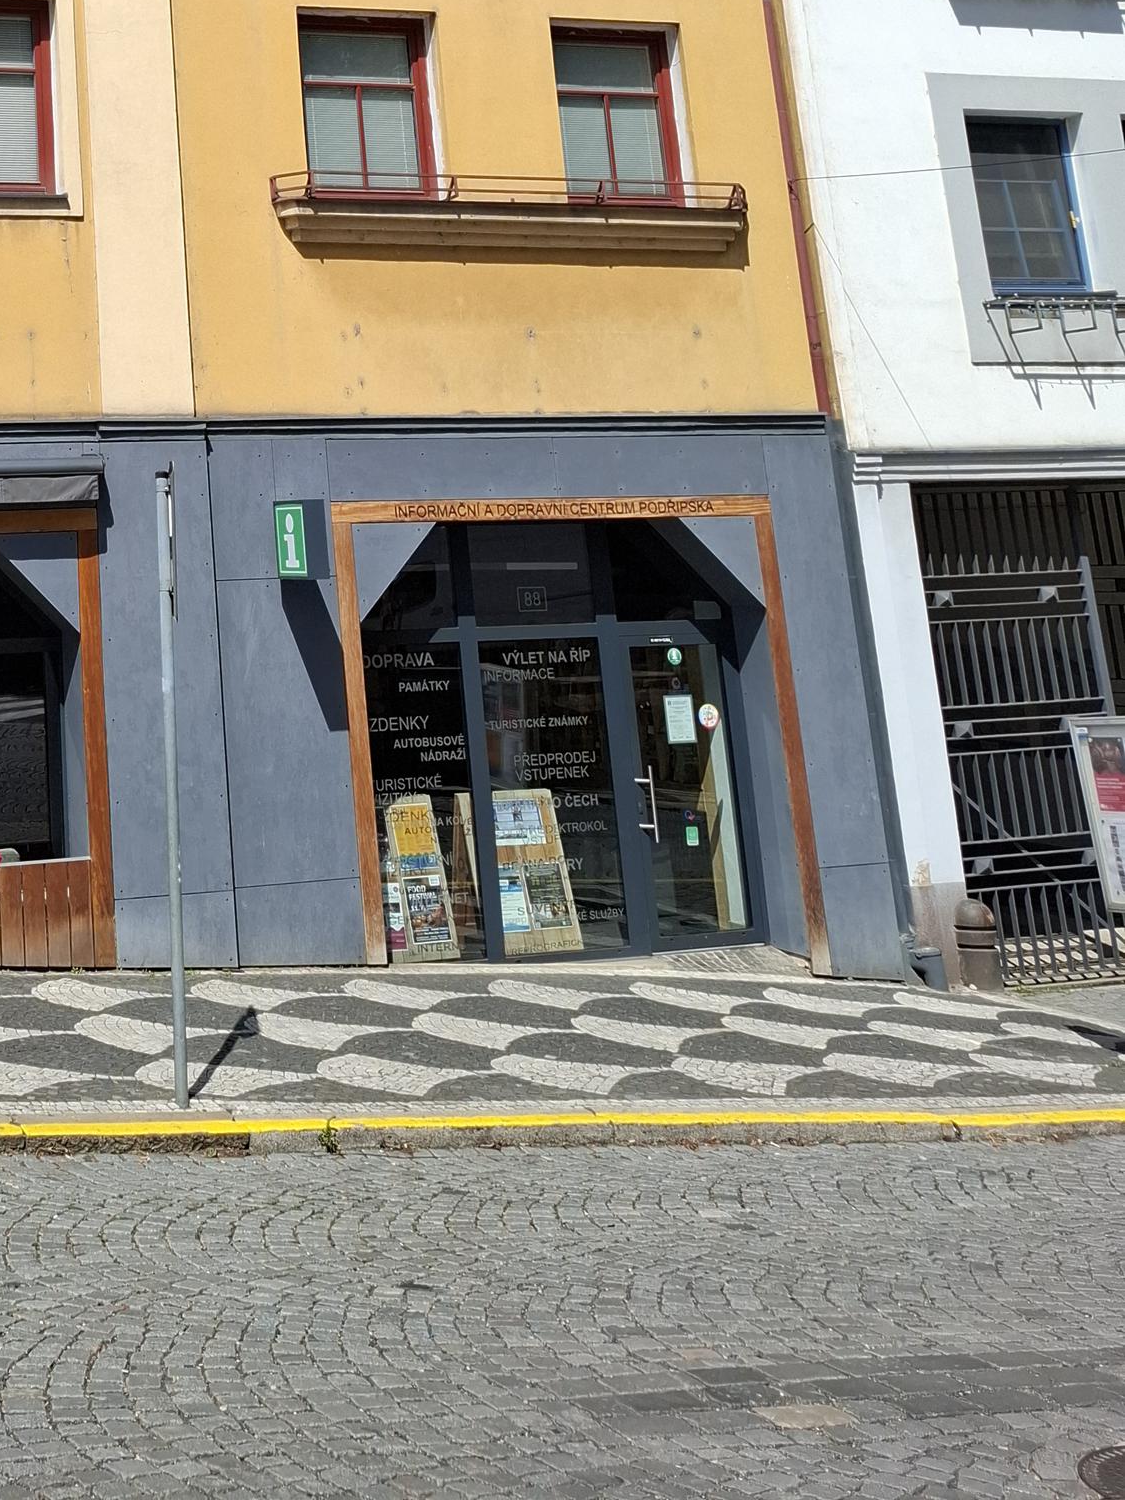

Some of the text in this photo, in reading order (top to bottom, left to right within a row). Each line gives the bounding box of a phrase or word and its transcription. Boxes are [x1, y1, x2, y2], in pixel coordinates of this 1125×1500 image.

[394, 502, 480, 518] INFORMAČNÍ
[484, 504, 493, 516] A
[569, 502, 635, 516] CENTRUM
[524, 591, 542, 606] 88
[502, 647, 591, 666] VÝLET NA ŘÍP
[483, 668, 556, 682] INFORMACE
[398, 679, 450, 693] PAMÁTKY
[370, 715, 429, 732] ZDENKY
[489, 715, 589, 730] TURISTICKÉ ZNÁMKY
[394, 733, 466, 749] AUTOBUSOVÉ
[420, 747, 467, 762] NÁDRAŽÍ
[514, 750, 596, 766] PŘEDPRODEJ
[516, 765, 590, 781] VSTUPENEK
[375, 773, 443, 792] URISTICKÉ
[565, 793, 600, 808] ČECH
[559, 820, 608, 834] KTROKOL
[589, 906, 625, 920] SLUŽBY
